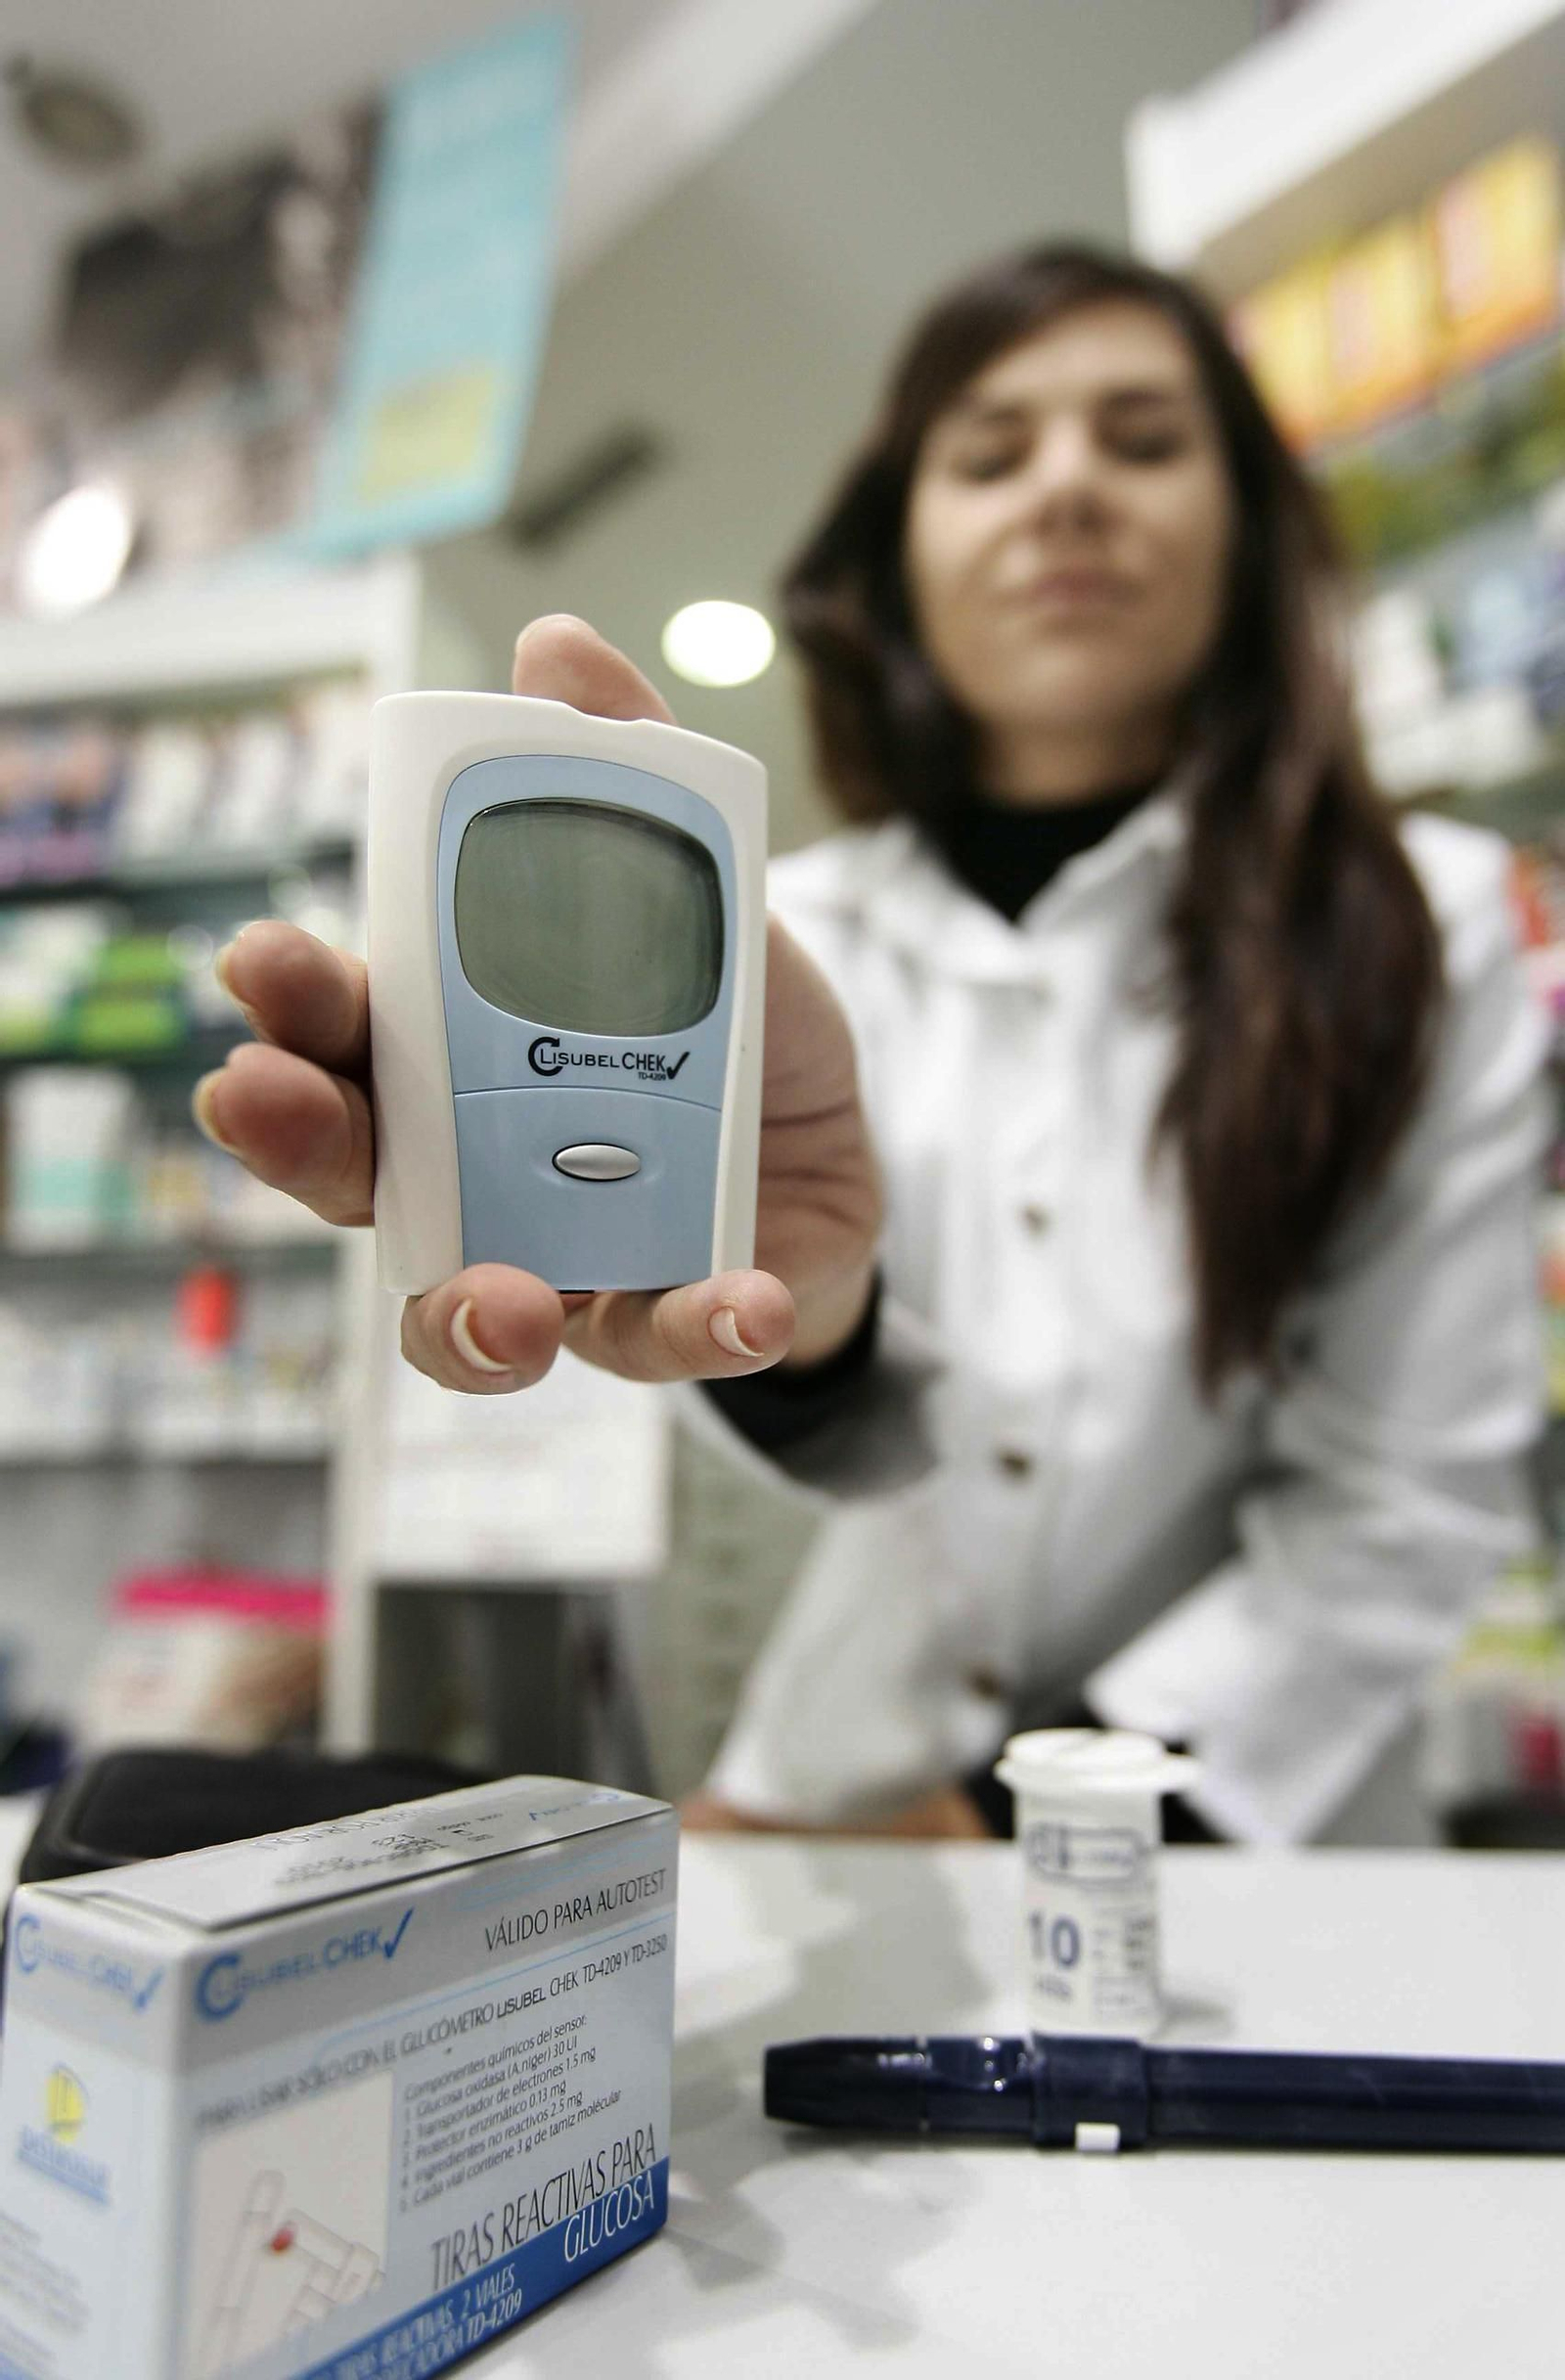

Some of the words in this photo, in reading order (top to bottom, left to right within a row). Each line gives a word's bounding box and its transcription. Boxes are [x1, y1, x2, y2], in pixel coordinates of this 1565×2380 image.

[621, 1052, 666, 1073] CHEK
[485, 1908, 549, 1952] VÁLIDO
[554, 1895, 592, 1929] PARA
[596, 1868, 666, 1914] AUTOTEST
[400, 2001, 493, 2055] GLUCÓMETRO
[550, 1969, 579, 1997] CHEK
[582, 1951, 622, 1985] TD-4209
[623, 1951, 632, 1966] Y
[632, 1933, 668, 1964] TD-3250
[405, 2058, 486, 2100] Componentes
[488, 2035, 535, 2067] químicos
[537, 2028, 553, 2045] del
[417, 2084, 464, 2117] Glucosa
[465, 2067, 506, 2096] oxidasa
[553, 2042, 564, 2058] 30
[565, 2035, 578, 2052] UI
[417, 2095, 494, 2138] Transportador
[497, 2083, 510, 2102] de
[513, 2059, 564, 2097] electrones
[565, 2052, 579, 2071] 1.5
[580, 2046, 596, 2064] mg
[414, 2176, 444, 2203] Cada
[446, 2166, 466, 2190] vial
[467, 2146, 514, 2179] contiene
[516, 2139, 523, 2153] 3
[525, 2135, 532, 2153] g
[534, 2126, 548, 2145] de
[550, 2111, 576, 2136] tamiz
[577, 2088, 623, 2125] molécular
[415, 2141, 485, 2182] Ingredientes
[488, 2132, 503, 2149] no
[505, 2109, 550, 2141] reactivos
[551, 2098, 565, 2118] 2.5
[566, 2090, 583, 2108] mg
[416, 2130, 466, 2161] Protector
[468, 2099, 527, 2136] enzimático
[550, 2079, 567, 2098] mg
[431, 2207, 495, 2291] TIRAS
[502, 2150, 606, 2253] REACTIVAS
[611, 2123, 656, 2188] PARA
[563, 2170, 655, 2263] GLUCOSA
[461, 2288, 471, 2321] 2
[475, 2262, 516, 2310] VIALES
[467, 2287, 523, 2342] TD-4209
